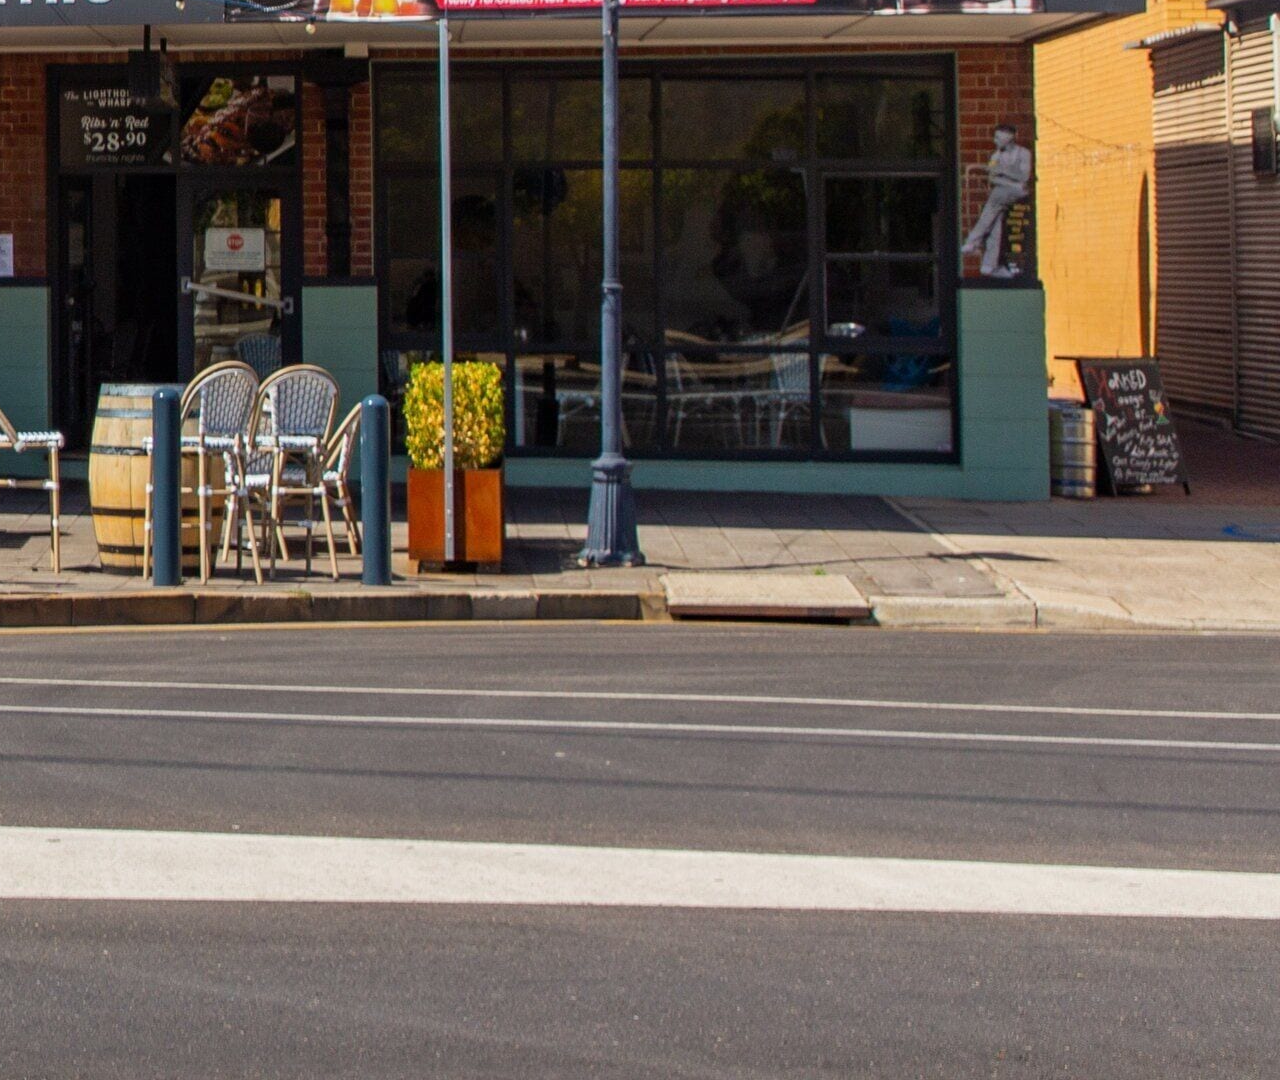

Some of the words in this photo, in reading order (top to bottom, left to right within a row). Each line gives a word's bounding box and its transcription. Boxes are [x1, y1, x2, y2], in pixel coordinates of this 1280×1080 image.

[83, 88, 130, 101] LIGHTHO
[98, 99, 131, 108] WHARF
[81, 115, 107, 130] Ribs
[83, 131, 147, 152] $28.90
